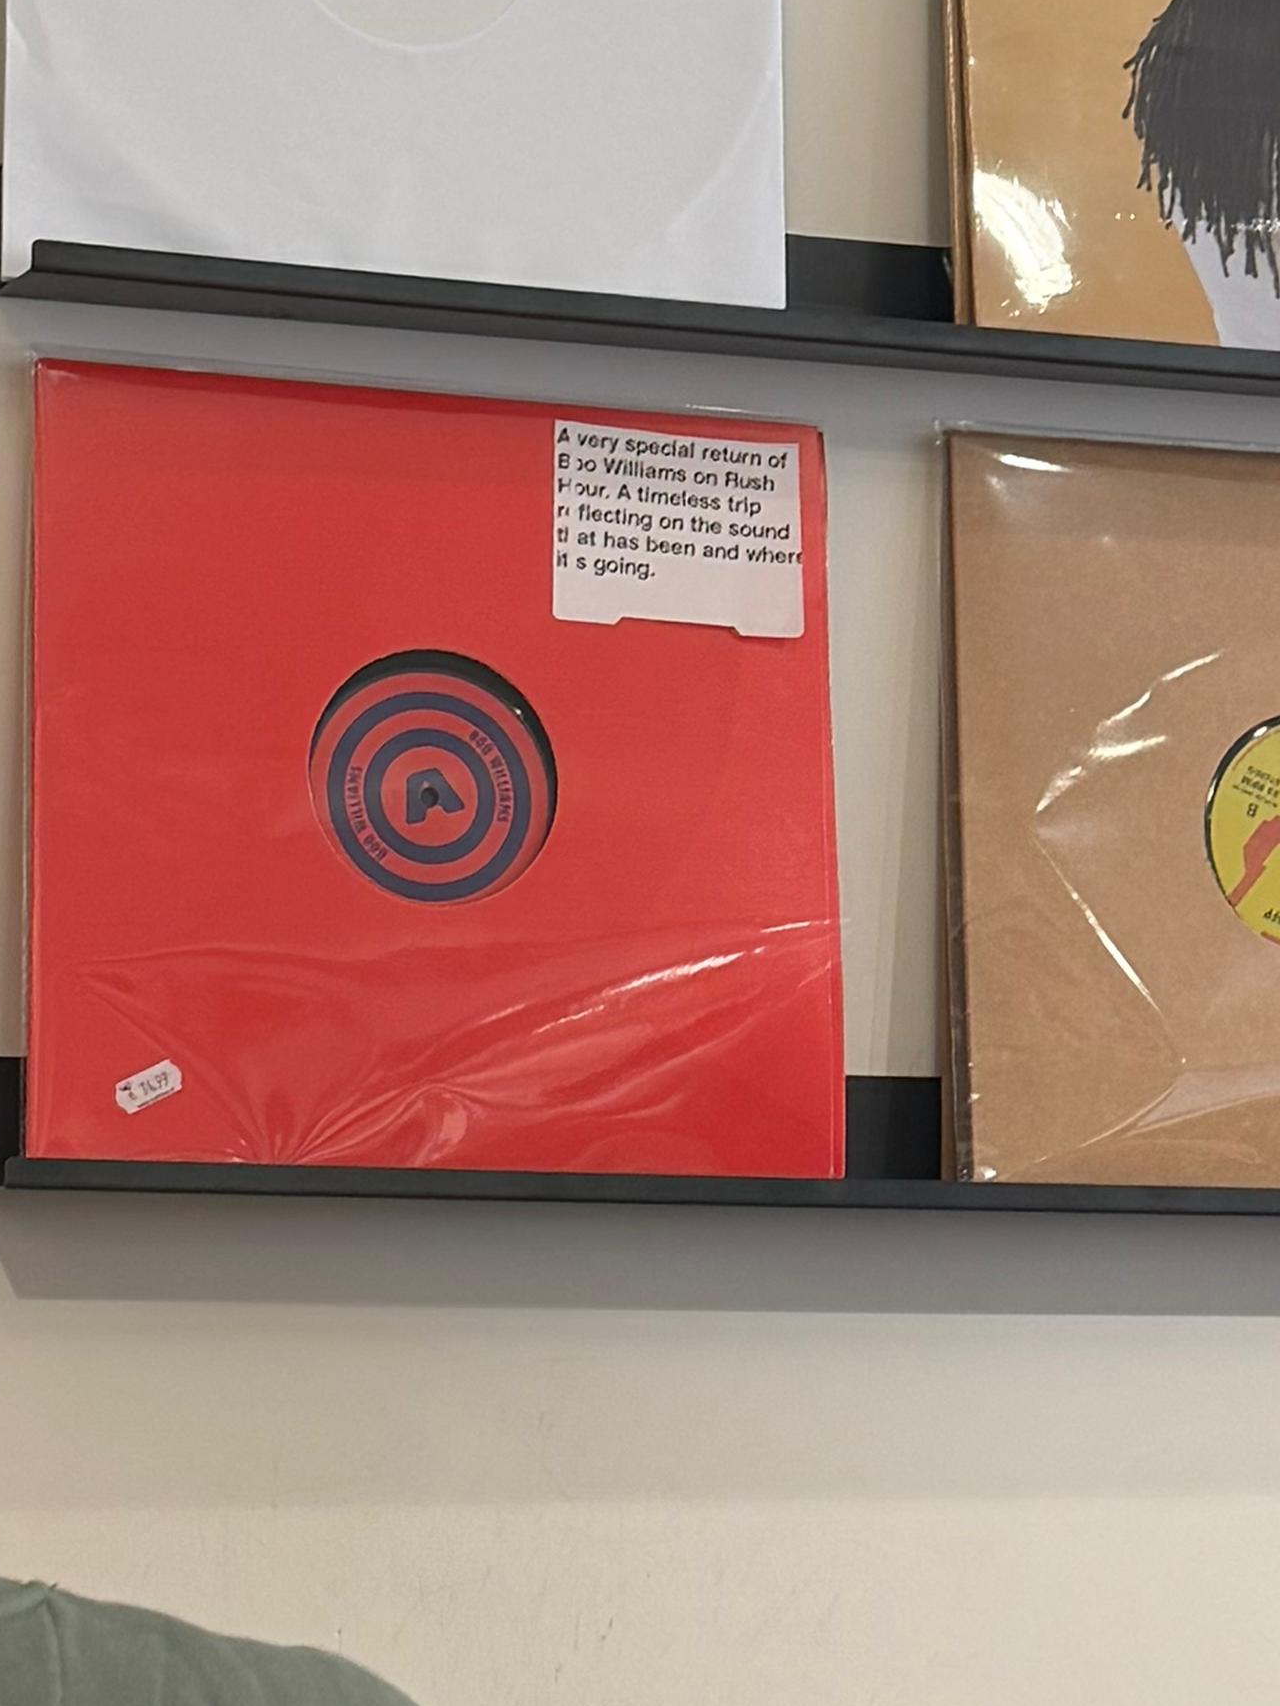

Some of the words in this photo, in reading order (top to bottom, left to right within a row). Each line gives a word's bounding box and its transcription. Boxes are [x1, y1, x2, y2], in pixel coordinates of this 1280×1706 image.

[557, 428, 570, 444] A
[577, 433, 618, 454] very
[625, 438, 695, 461] special
[702, 446, 762, 467] return
[769, 451, 787, 469] of
[604, 458, 686, 483] Williams
[694, 472, 718, 487] on
[725, 472, 774, 491] Rush
[618, 485, 632, 500] A
[637, 487, 721, 510] timeless
[728, 496, 762, 517] trip
[659, 516, 684, 531] on
[691, 517, 722, 535] the
[729, 522, 790, 540] sound
[604, 532, 639, 551] has
[647, 536, 695, 557] been
[703, 541, 739, 561] and
[594, 558, 655, 581] going.
[345, 766, 367, 834] WILLIAMS
[406, 767, 465, 824] A
[488, 752, 514, 823] WILLIAMS
[1247, 804, 1259, 818] B
